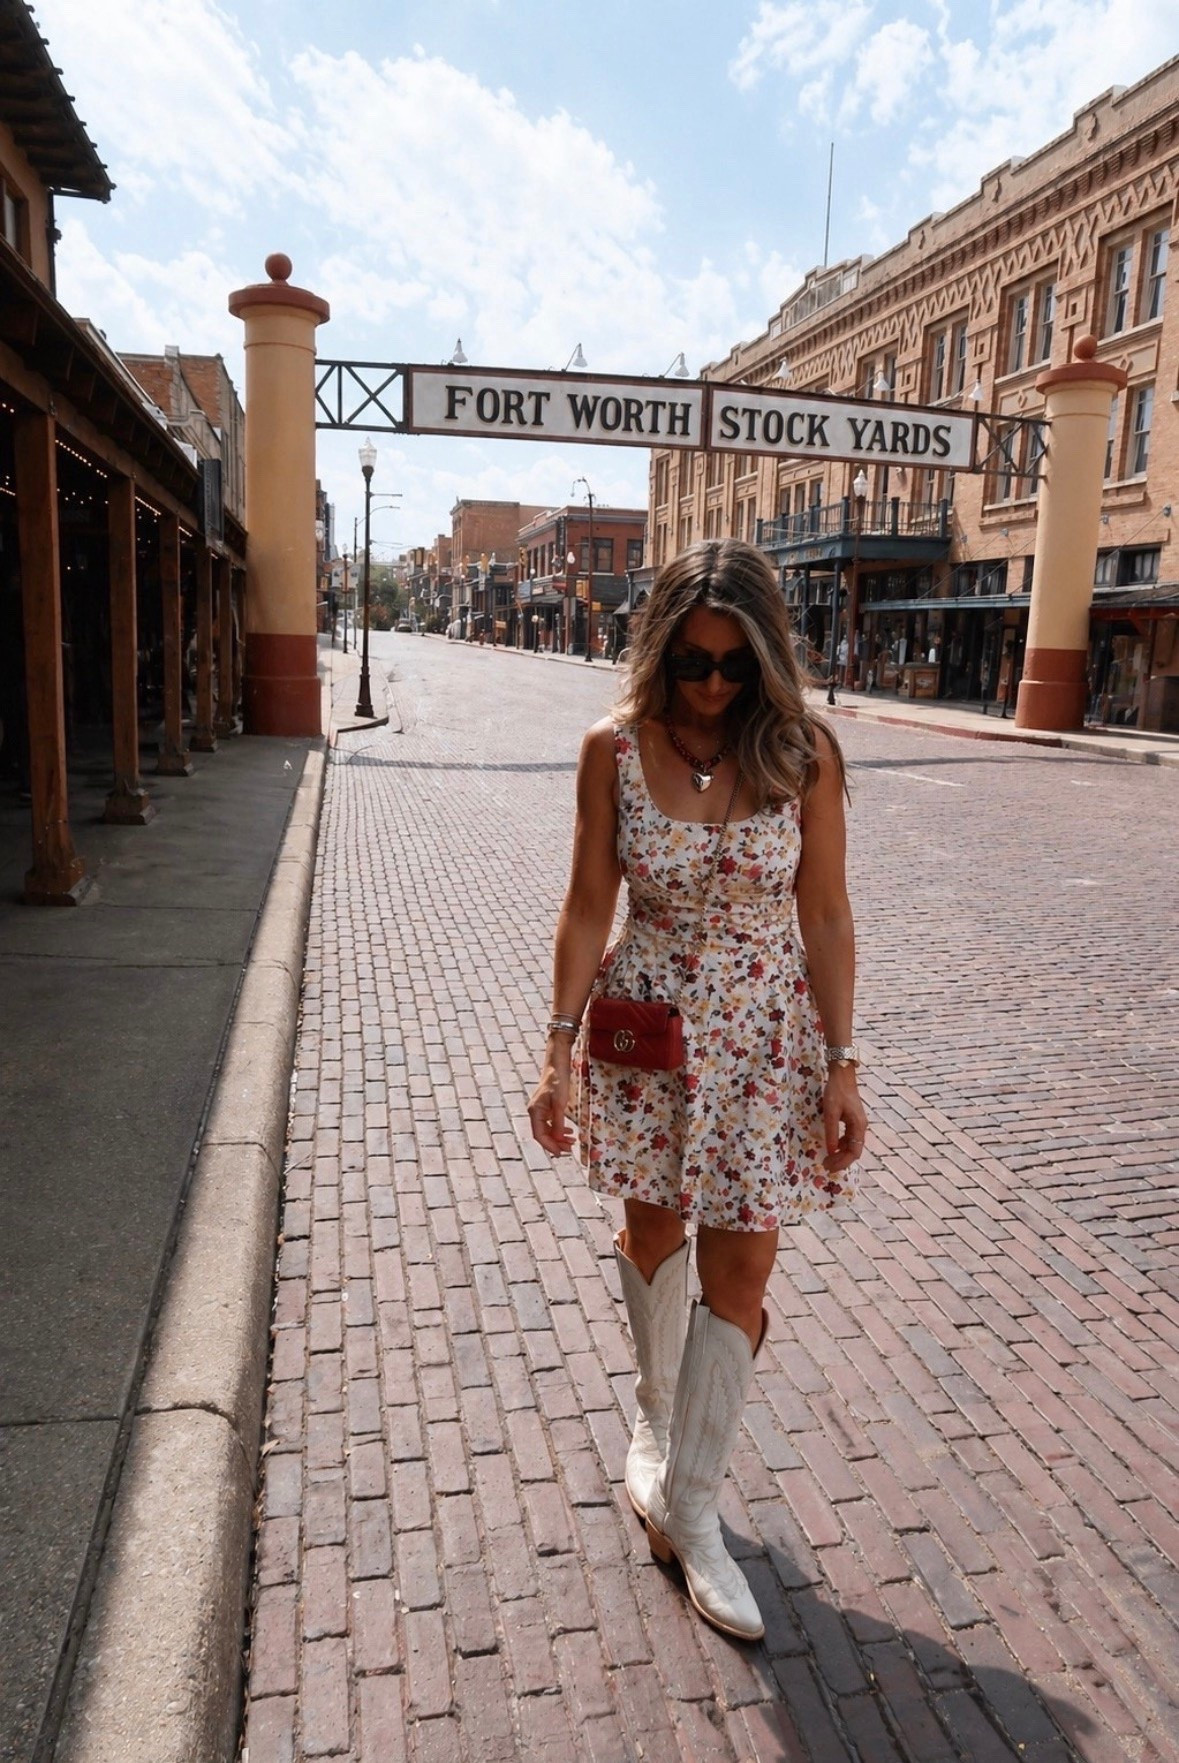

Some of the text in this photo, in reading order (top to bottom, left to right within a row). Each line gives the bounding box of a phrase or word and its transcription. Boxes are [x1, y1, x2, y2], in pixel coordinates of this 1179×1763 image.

[445, 385, 692, 436] FORT WORTH
[719, 405, 951, 457] STOCK YARDS
